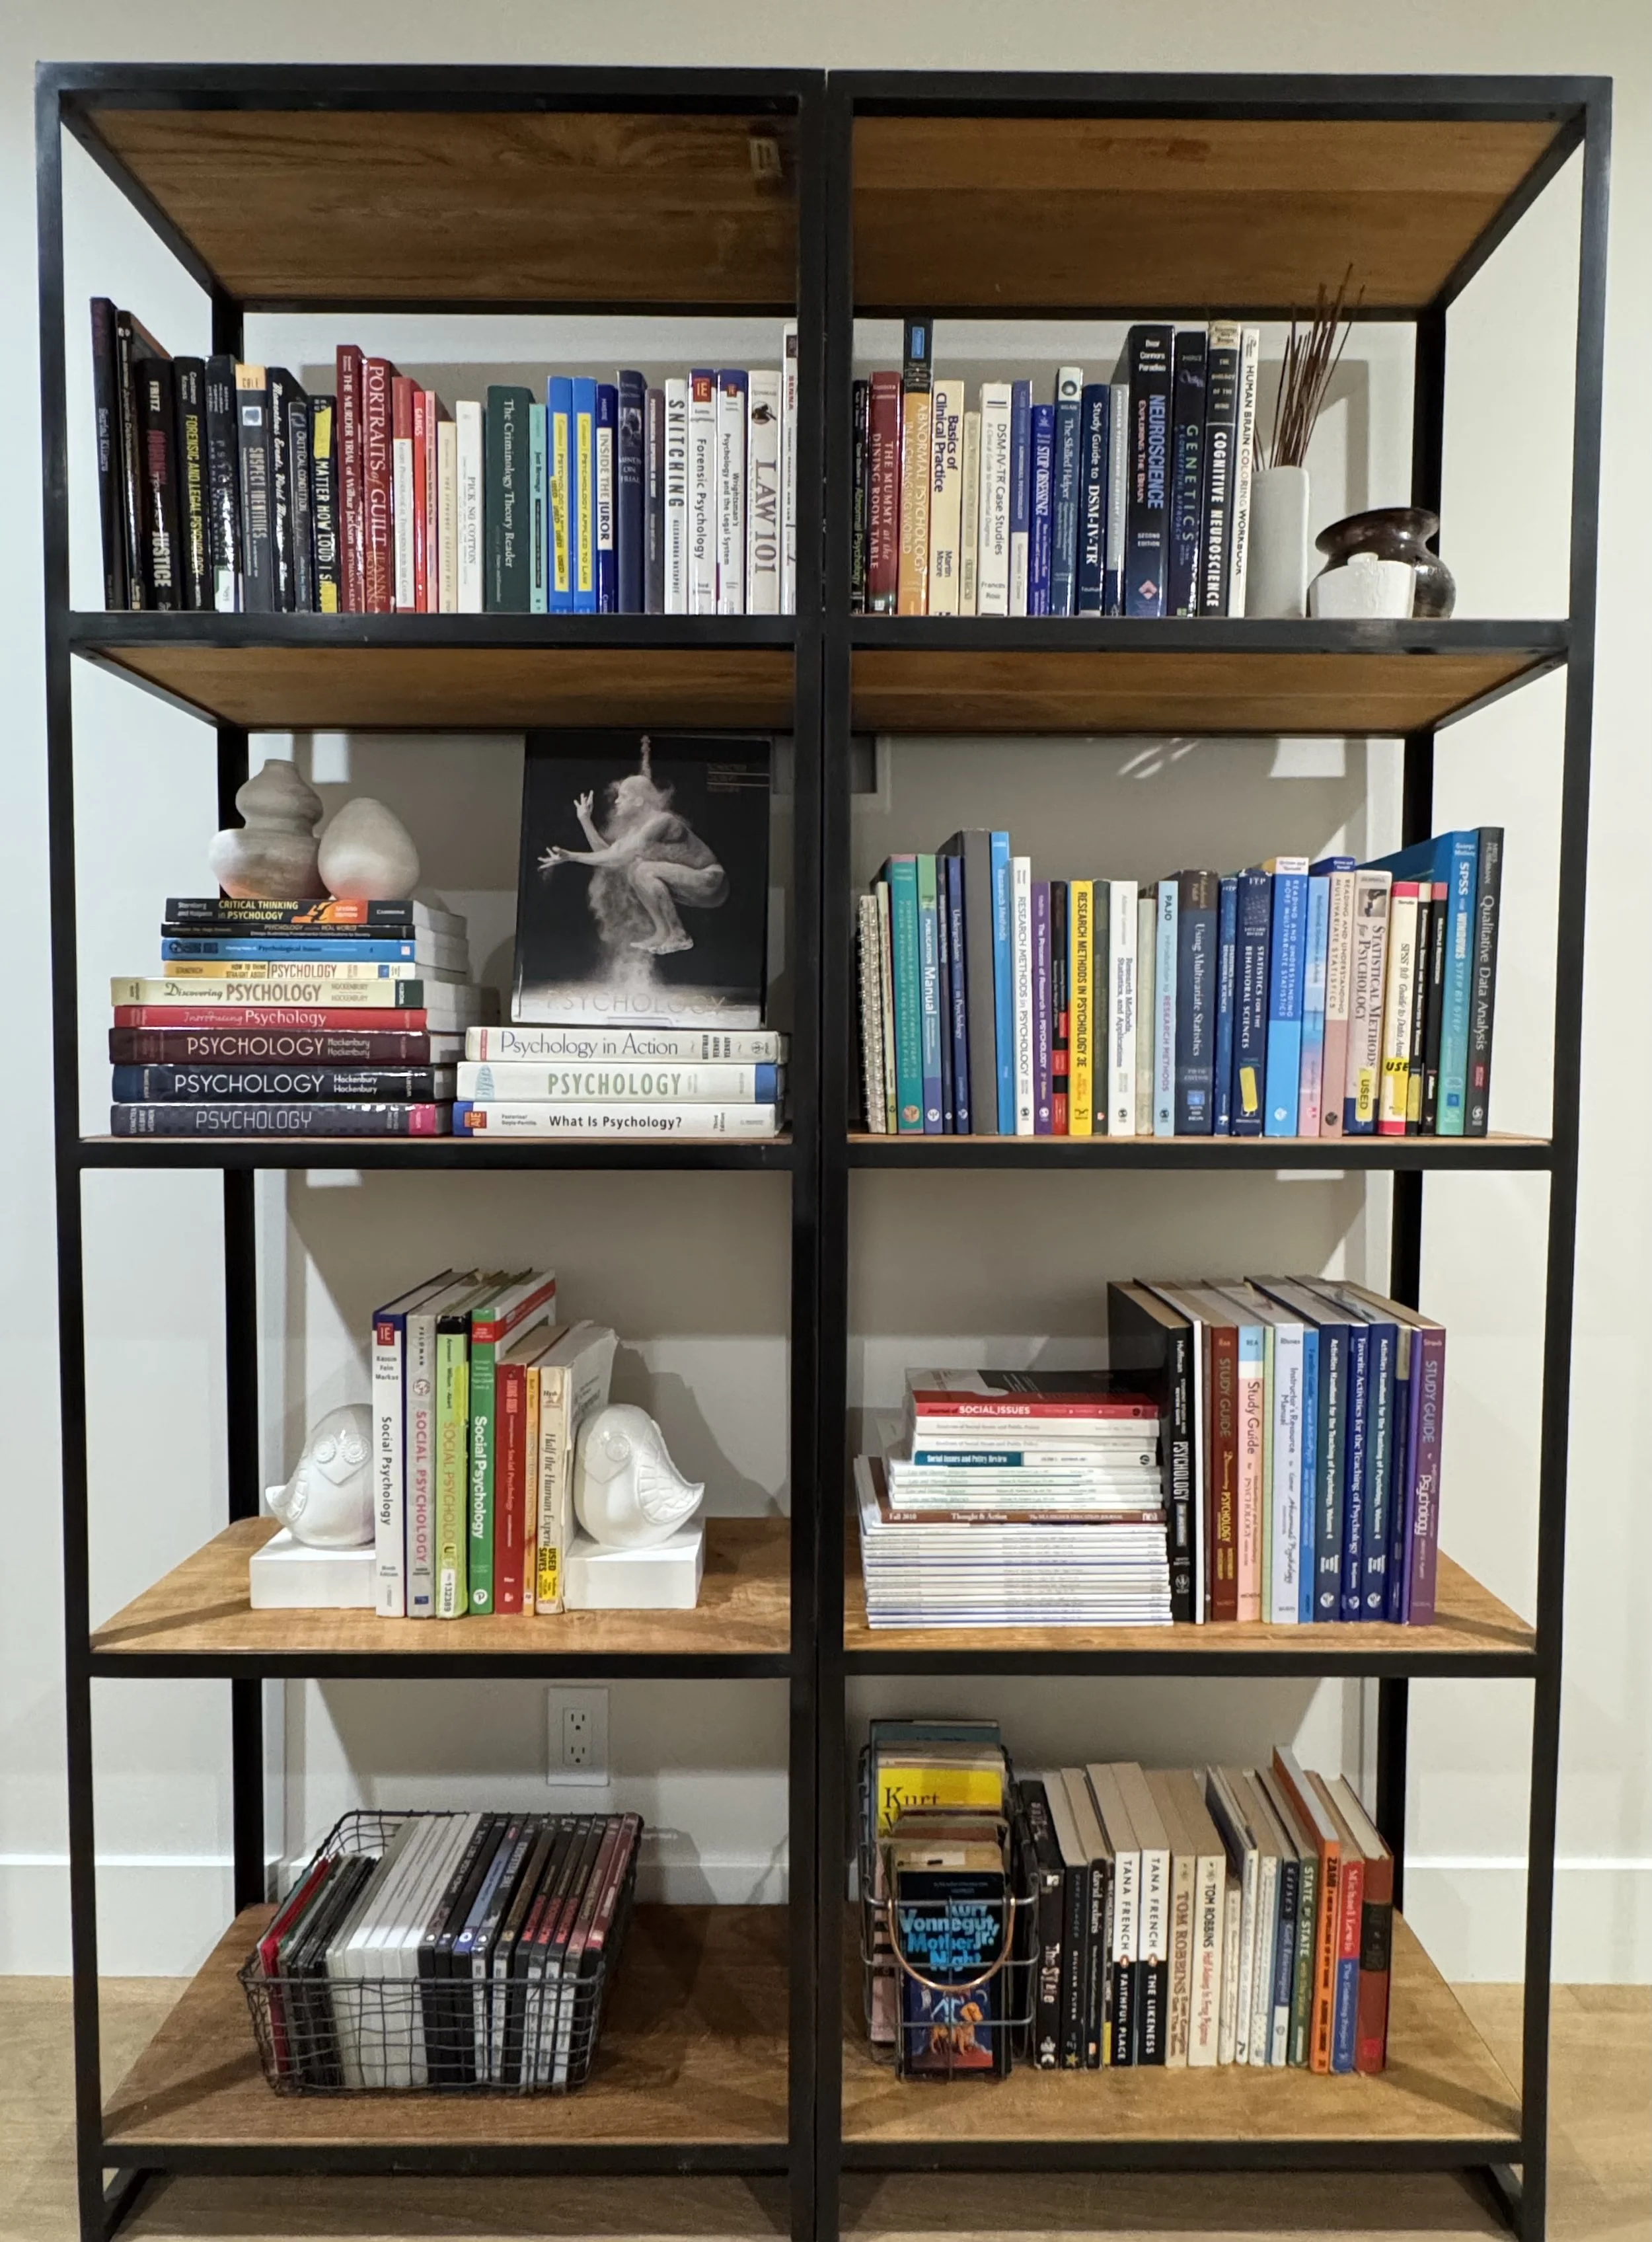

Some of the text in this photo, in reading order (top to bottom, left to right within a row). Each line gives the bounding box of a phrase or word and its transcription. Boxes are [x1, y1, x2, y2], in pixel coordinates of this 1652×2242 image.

[149, 381, 160, 411] FRITZ
[186, 415, 200, 461] FORENSIC
[296, 431, 307, 469] CRITICAL
[366, 366, 387, 546] PORTRAITS of GUILT
[669, 400, 685, 507] SNITCHING
[915, 403, 929, 479] ABNORMAL
[934, 393, 948, 492] Clinical Practice
[947, 416, 958, 471] Basics of
[1037, 446, 1049, 467] STOP
[1147, 394, 1166, 508] NEUROSCIENCE
[188, 462, 200, 482] AND
[189, 484, 202, 512] LEGAL
[249, 447, 268, 538] SUSPECT IDENTITIES
[315, 461, 330, 501] MATTER
[502, 399, 515, 567] The Criminology Theory Reader
[599, 434, 610, 541] INSIDE THE JUROR
[694, 439, 708, 559] Forensic Psychology
[870, 434, 881, 568] DINING ROOM TABLE
[995, 424, 1007, 555] DSM-IV-TR Case Studies
[1086, 403, 1103, 564] Study Guide to DSM-IV-TR
[1183, 424, 1198, 541] GENETICS
[317, 506, 331, 529] HOW
[754, 459, 777, 574] LAW 101
[852, 487, 864, 585] Abnormal Psychology
[915, 485, 927, 574] PSYCHOLOGY
[1206, 432, 1227, 607] COGNITIVE NEUROSCIENCE
[152, 531, 172, 587] JUSTICE
[318, 533, 332, 561] LOUD
[219, 900, 298, 909] CRITICAL THINKING
[163, 984, 322, 1002] Discovering PSYCHOLOGY
[272, 964, 336, 978] PSYCHOLOGY
[924, 967, 937, 1015] Manual
[1077, 892, 1087, 1067] RESEARCH METHODS IN PSYCHOLOGY 3E
[1191, 923, 1205, 1056] Using Multivariate Statistics
[1241, 945, 1253, 1049] BEHAVIORAL SCIENCES
[1355, 924, 1371, 1022] for PSYCHOLOGY
[1367, 925, 1385, 1067] STATISTICAL METHODS
[1474, 896, 1494, 1050] Qualitative Data Analysis
[187, 1037, 324, 1056] PSYCHOLOGY
[328, 1038, 370, 1049] Hockenbury
[328, 1047, 370, 1058] Hockenbury
[501, 1030, 678, 1058] Psychology in Action
[175, 1074, 324, 1093] PSYCHOLOGY
[334, 1074, 377, 1084] Hockenbury
[334, 1084, 377, 1095] Hockenbury
[548, 1073, 681, 1095] PSYCHOLOGY
[1359, 1079, 1370, 1110] USED
[196, 1111, 311, 1129] PSYCHOLOGY
[549, 1116, 682, 1130] What Is Psychology?
[1176, 1340, 1185, 1373] Huffman
[959, 1405, 1031, 1415] SOCIAL ISSUES
[1220, 1358, 1230, 1437] STUDY GUIDE
[1245, 1381, 1259, 1454] Study Guide
[1281, 1395, 1289, 1425] Manual
[1423, 1360, 1437, 1444] STUDY GUIDE
[381, 1416, 393, 1525] Social Psychology
[542, 1434, 556, 1511] Half the Human
[1174, 1441, 1189, 1501] PSYCHOLOGY
[1349, 1338, 1366, 1554] Favorite Activities for the Teaching of Psychology
[416, 1411, 427, 1563] SOCIAL PSYCHOLOGY
[472, 1416, 487, 1539] Social Psychology
[1414, 1475, 1433, 1535] Psychology
[1221, 1492, 1231, 1542] PSYCHOLOGY
[539, 1548, 547, 1572] SAVES
[548, 1548, 557, 1571] USED
[884, 1787, 940, 1809] Kurt
[1092, 1871, 1103, 1898] david
[1121, 1860, 1132, 1951] TANA FRENCH
[1148, 1857, 1160, 1947] TANA FRENCH
[1343, 1869, 1359, 1951] Michael Lewis
[899, 1909, 1000, 1937] Vonnegut,
[907, 1933, 973, 1953] Mother
[1092, 1900, 1102, 1933] sedaris
[1174, 1891, 1189, 1994] TOM ROBBINS
[1203, 1884, 1216, 1947] TOM ROBBINS
[930, 1951, 982, 1972] Night
[1117, 1974, 1129, 2059] FAITHFUL PLACE
[1145, 1974, 1157, 2054] THE LIKENESS
